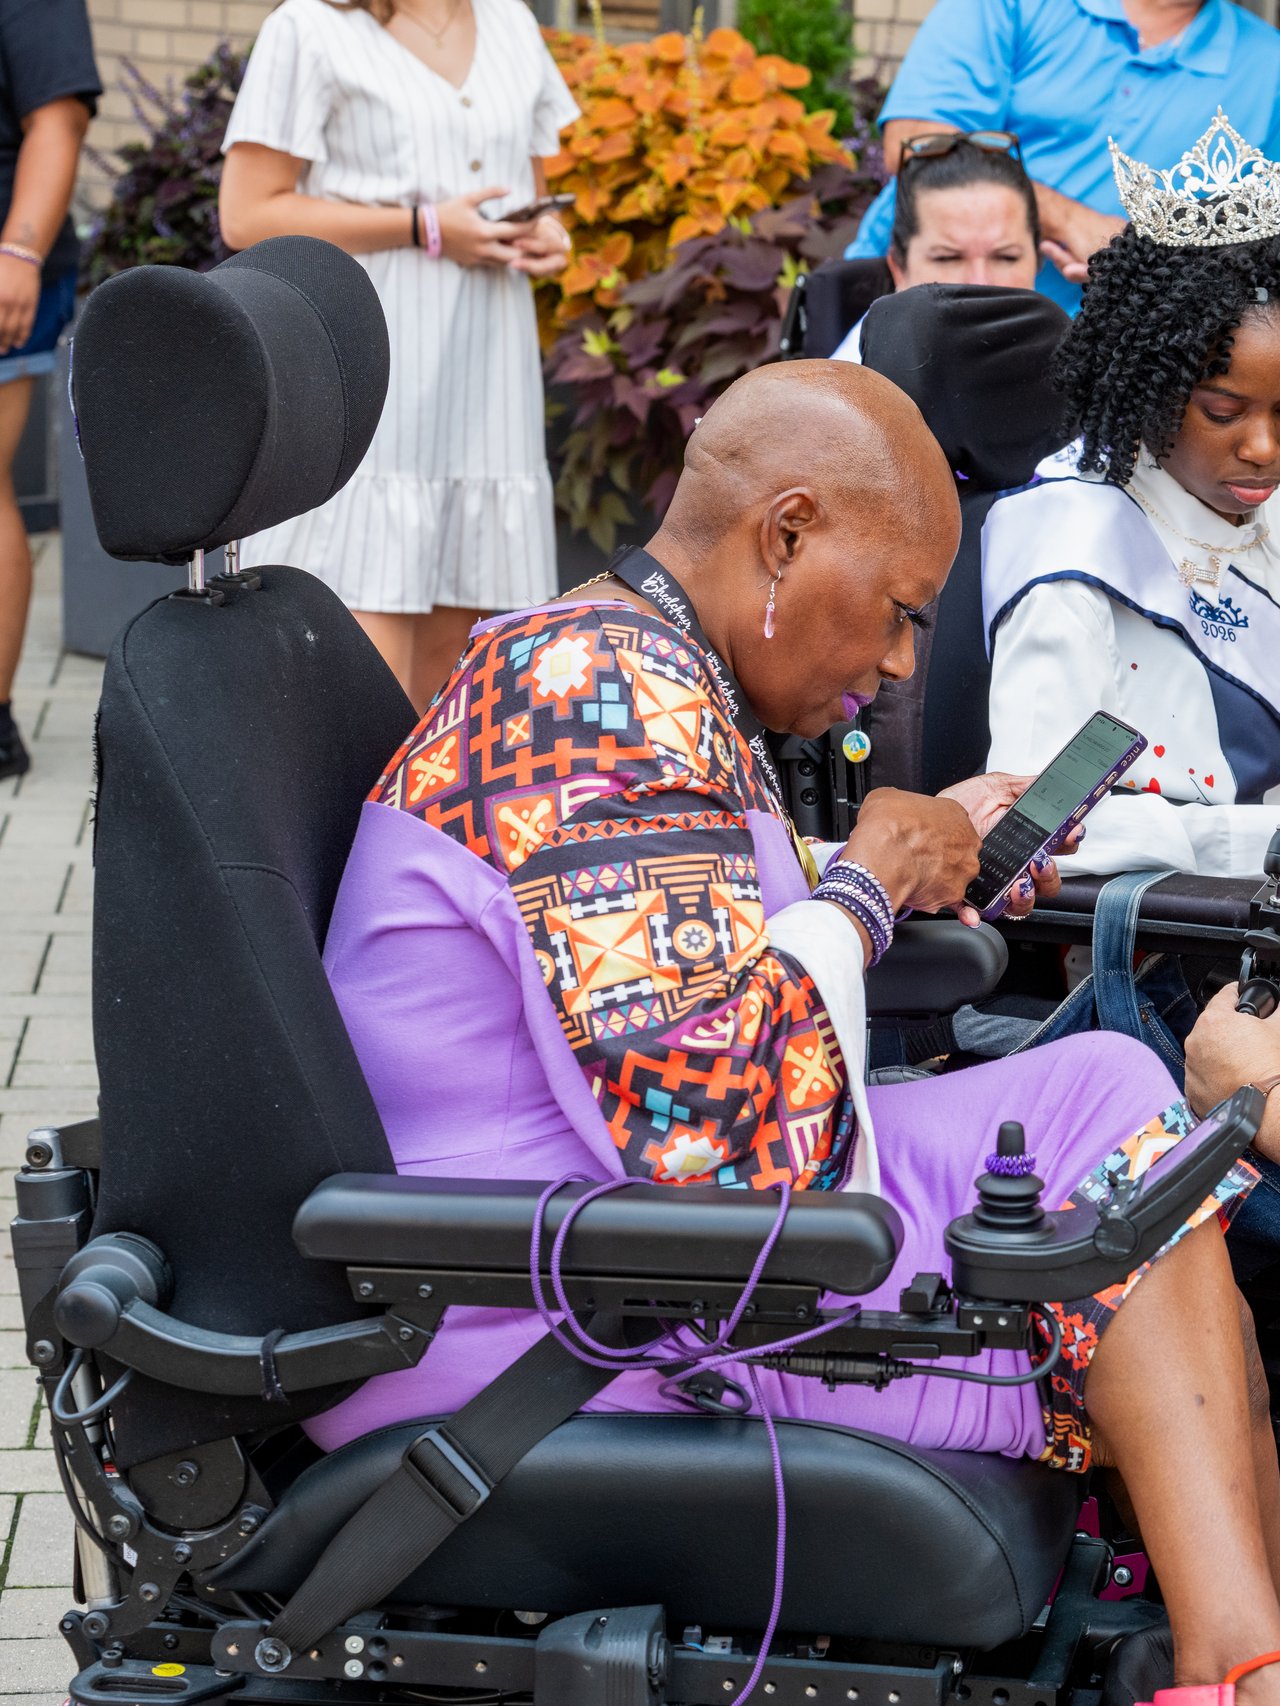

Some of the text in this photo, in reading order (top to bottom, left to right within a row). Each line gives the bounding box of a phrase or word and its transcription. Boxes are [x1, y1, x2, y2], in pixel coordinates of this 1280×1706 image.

[641, 571, 692, 631] Wheelchair
[1200, 620, 1237, 642] 2026
[1119, 745, 1141, 768] nice
